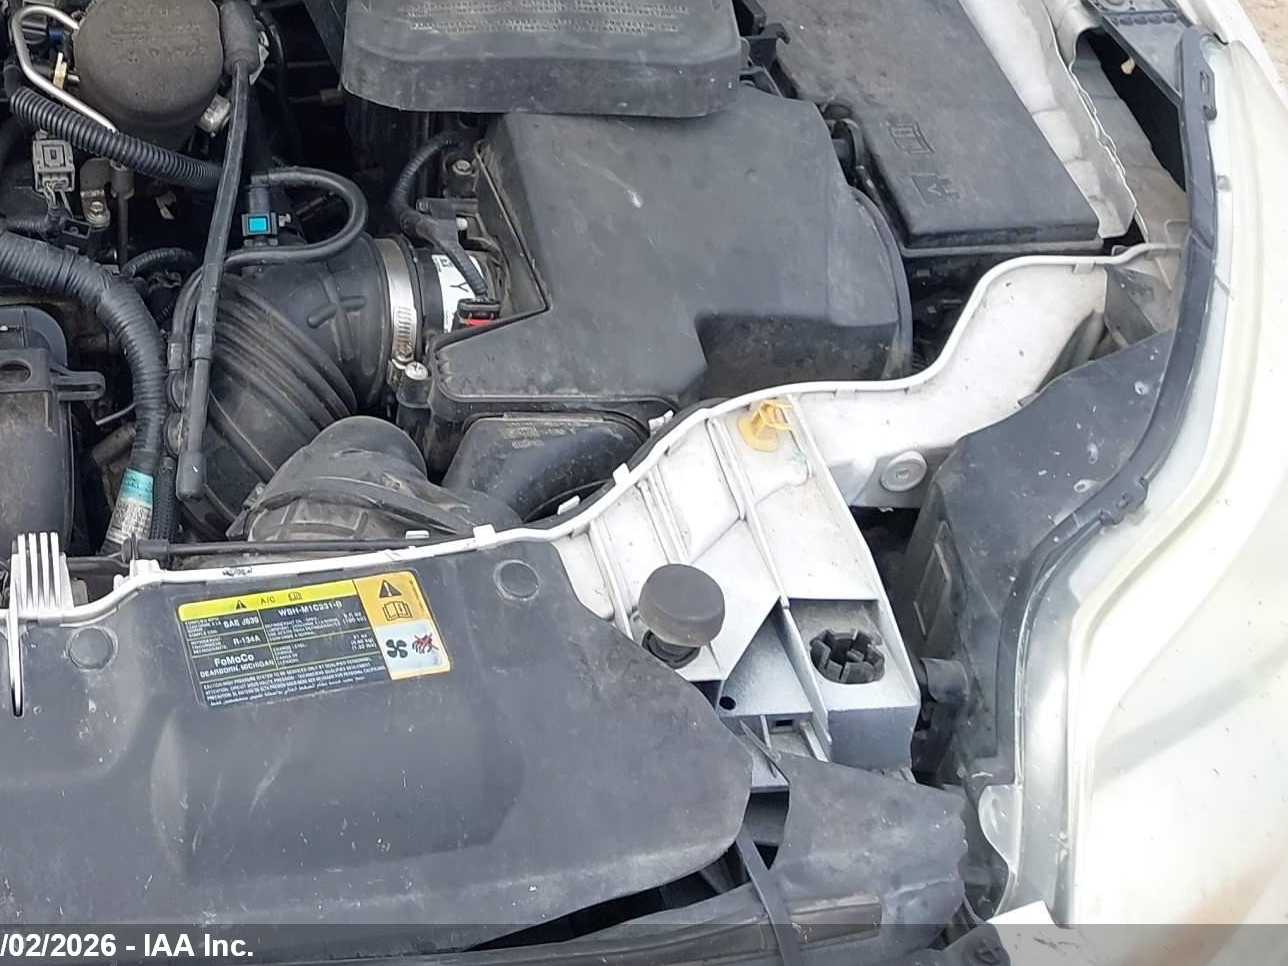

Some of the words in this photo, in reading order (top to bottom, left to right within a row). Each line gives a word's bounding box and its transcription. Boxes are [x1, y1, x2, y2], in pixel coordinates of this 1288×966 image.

[260, 596, 276, 605] A/C
[232, 634, 261, 645] R-134A
[213, 653, 255, 667] FoMoCo
